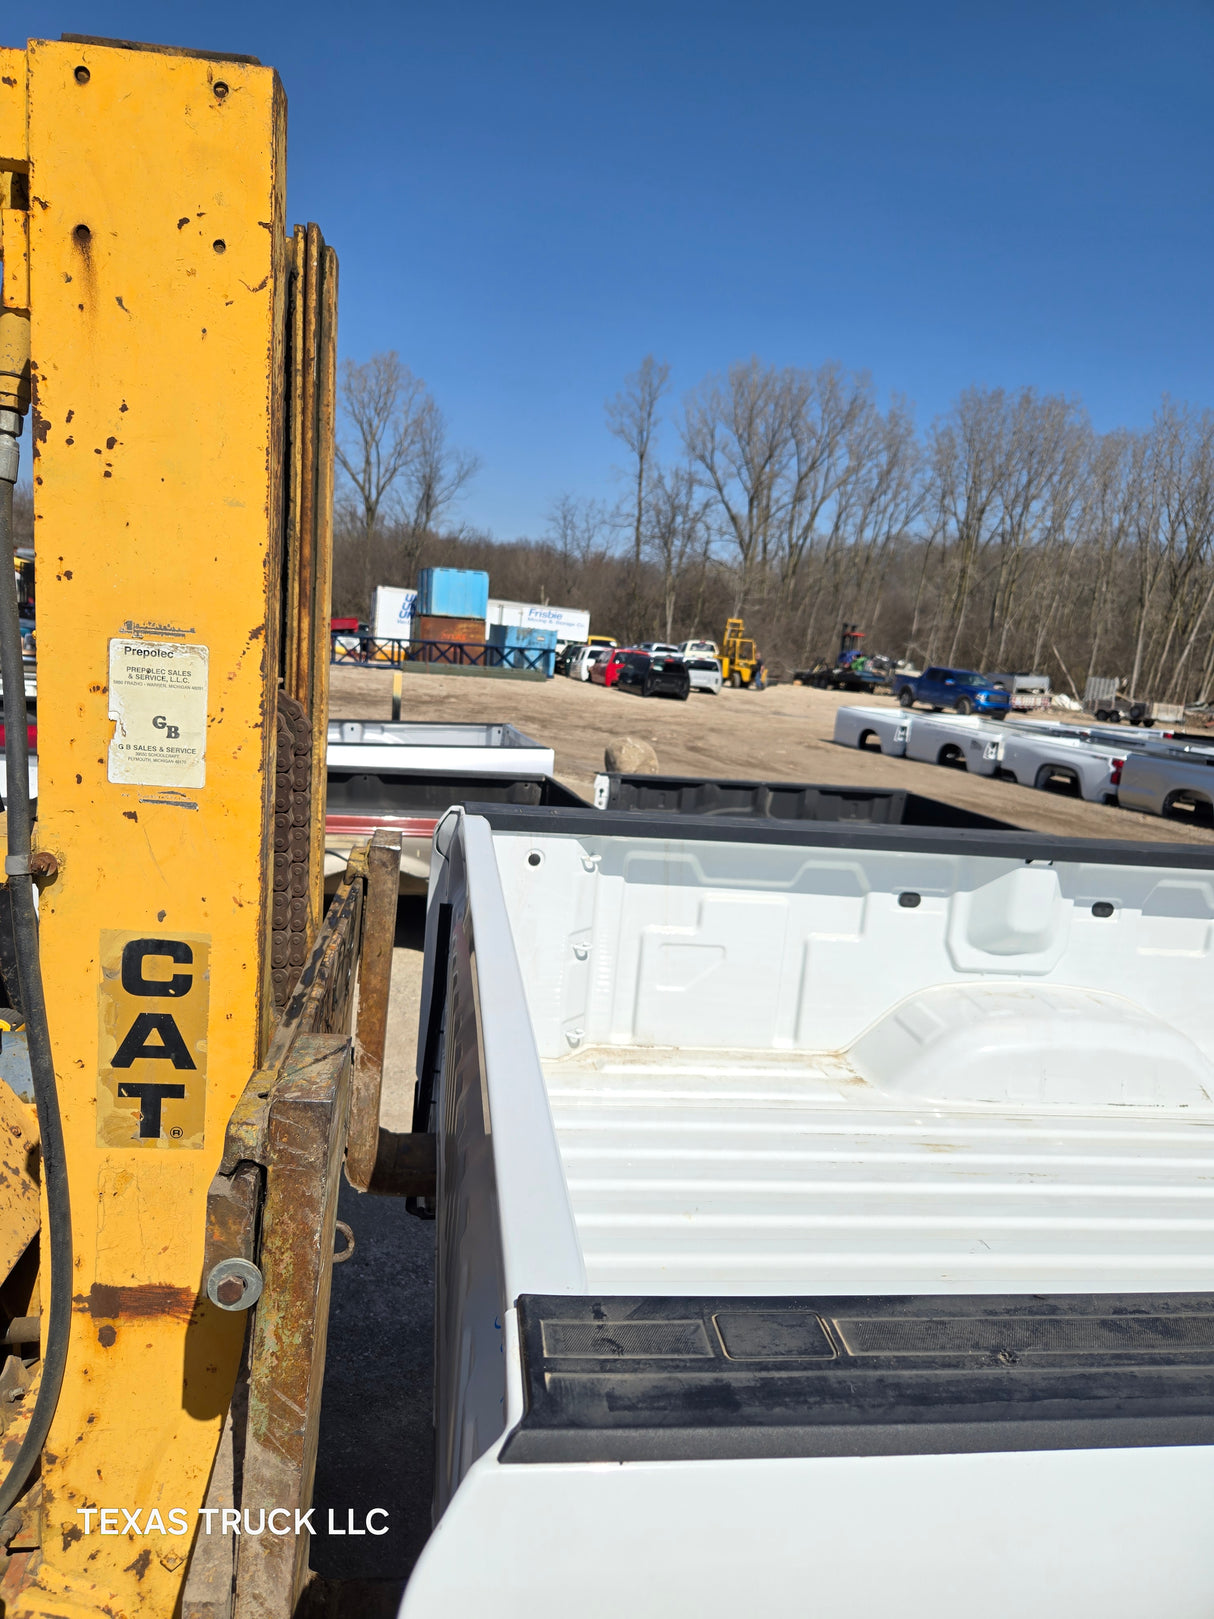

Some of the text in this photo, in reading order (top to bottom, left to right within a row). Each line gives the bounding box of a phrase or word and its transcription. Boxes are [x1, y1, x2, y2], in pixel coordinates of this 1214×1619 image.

[528, 608, 563, 620] Frisbie
[124, 646, 174, 659] Prepolec
[126, 666, 192, 677] PREPOLEC SALES
[135, 673, 168, 682] SERVICE,
[169, 676, 190, 684] L.L.C.
[133, 744, 157, 752] SALES
[166, 746, 197, 755] SERVICE
[110, 938, 197, 1139] CAT
